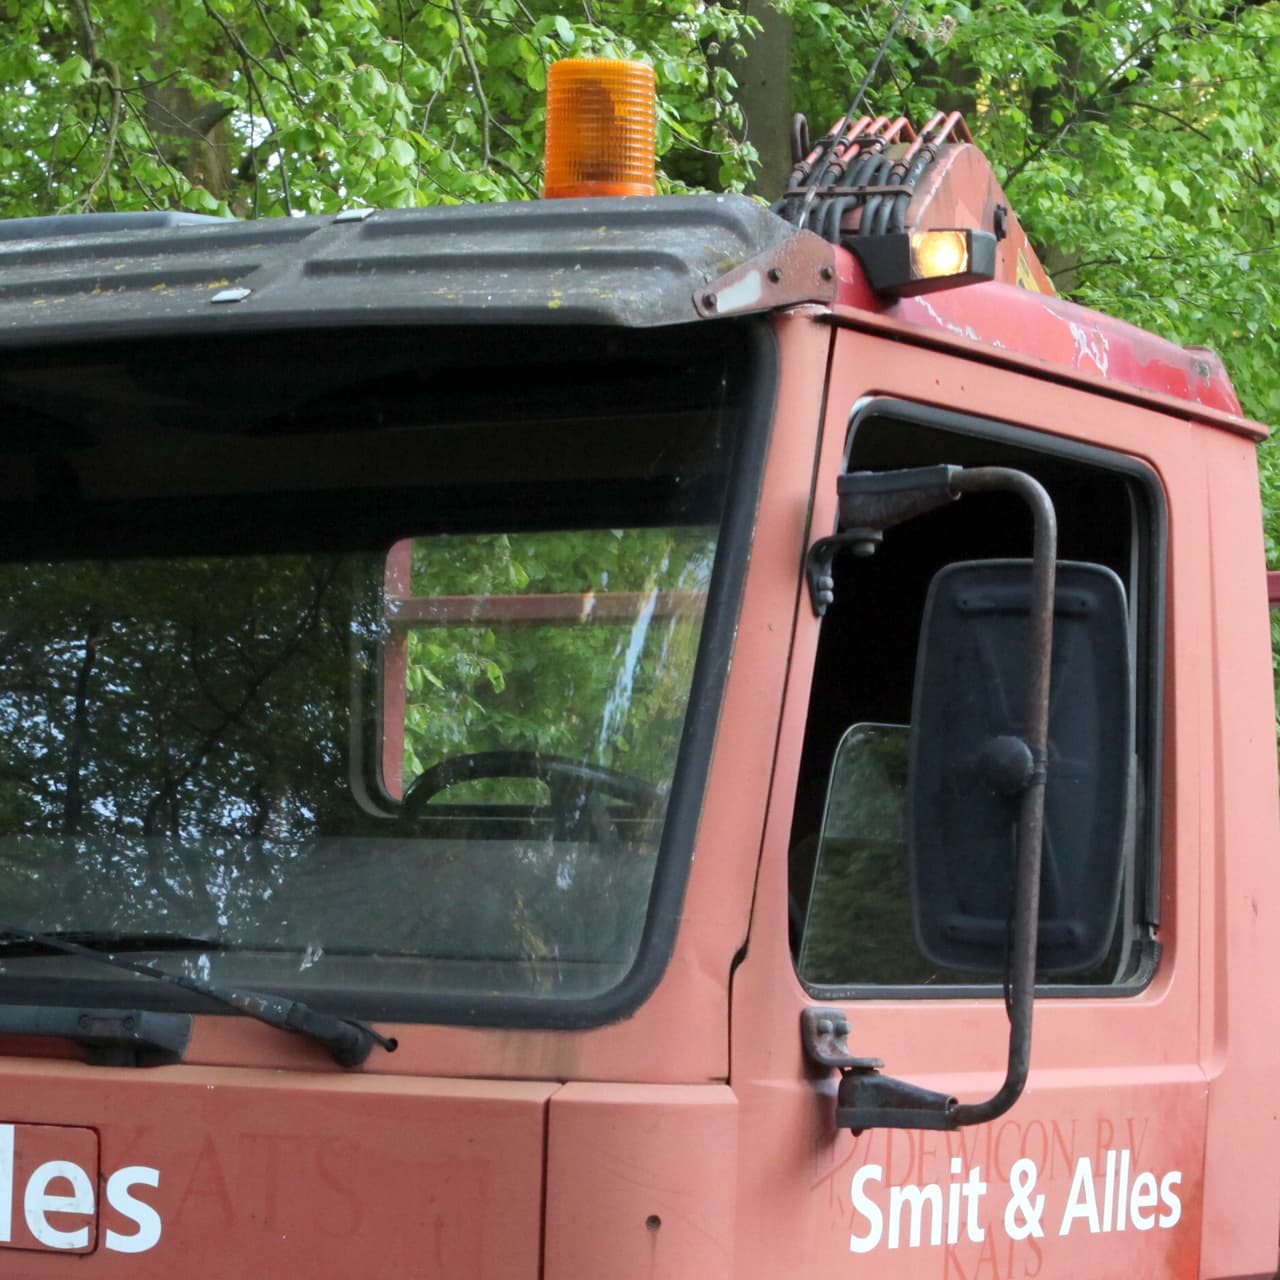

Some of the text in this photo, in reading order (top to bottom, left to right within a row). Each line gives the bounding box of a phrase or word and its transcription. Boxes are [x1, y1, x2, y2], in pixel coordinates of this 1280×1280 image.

[849, 1149, 1182, 1254] Smit & Alles
